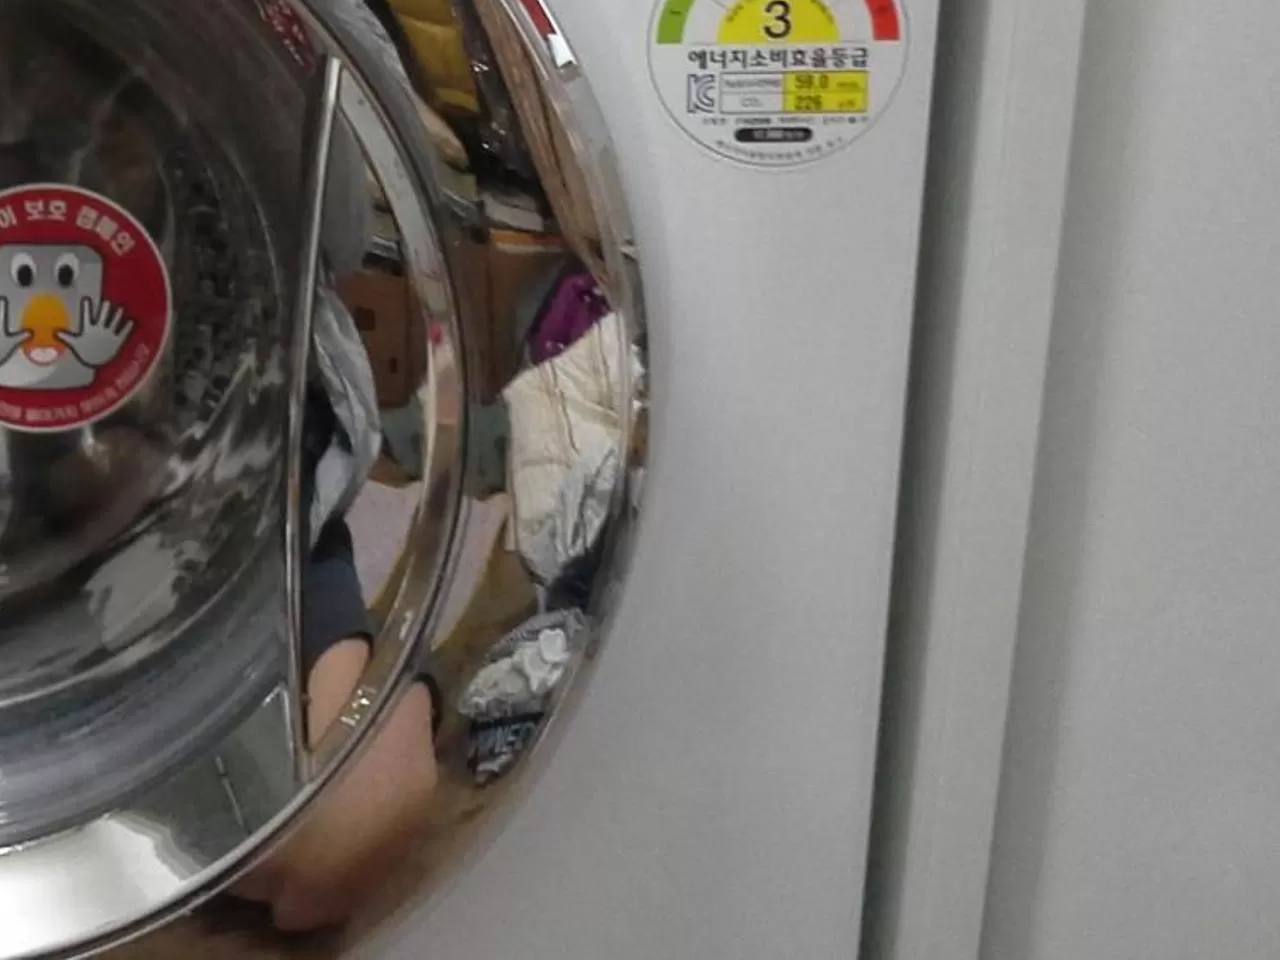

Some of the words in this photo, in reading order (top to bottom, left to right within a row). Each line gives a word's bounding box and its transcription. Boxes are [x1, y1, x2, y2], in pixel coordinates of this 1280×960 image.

[762, 0, 793, 39] 3
[687, 46, 869, 69] 에너지소비효율등급
[24, 200, 68, 221] 보호
